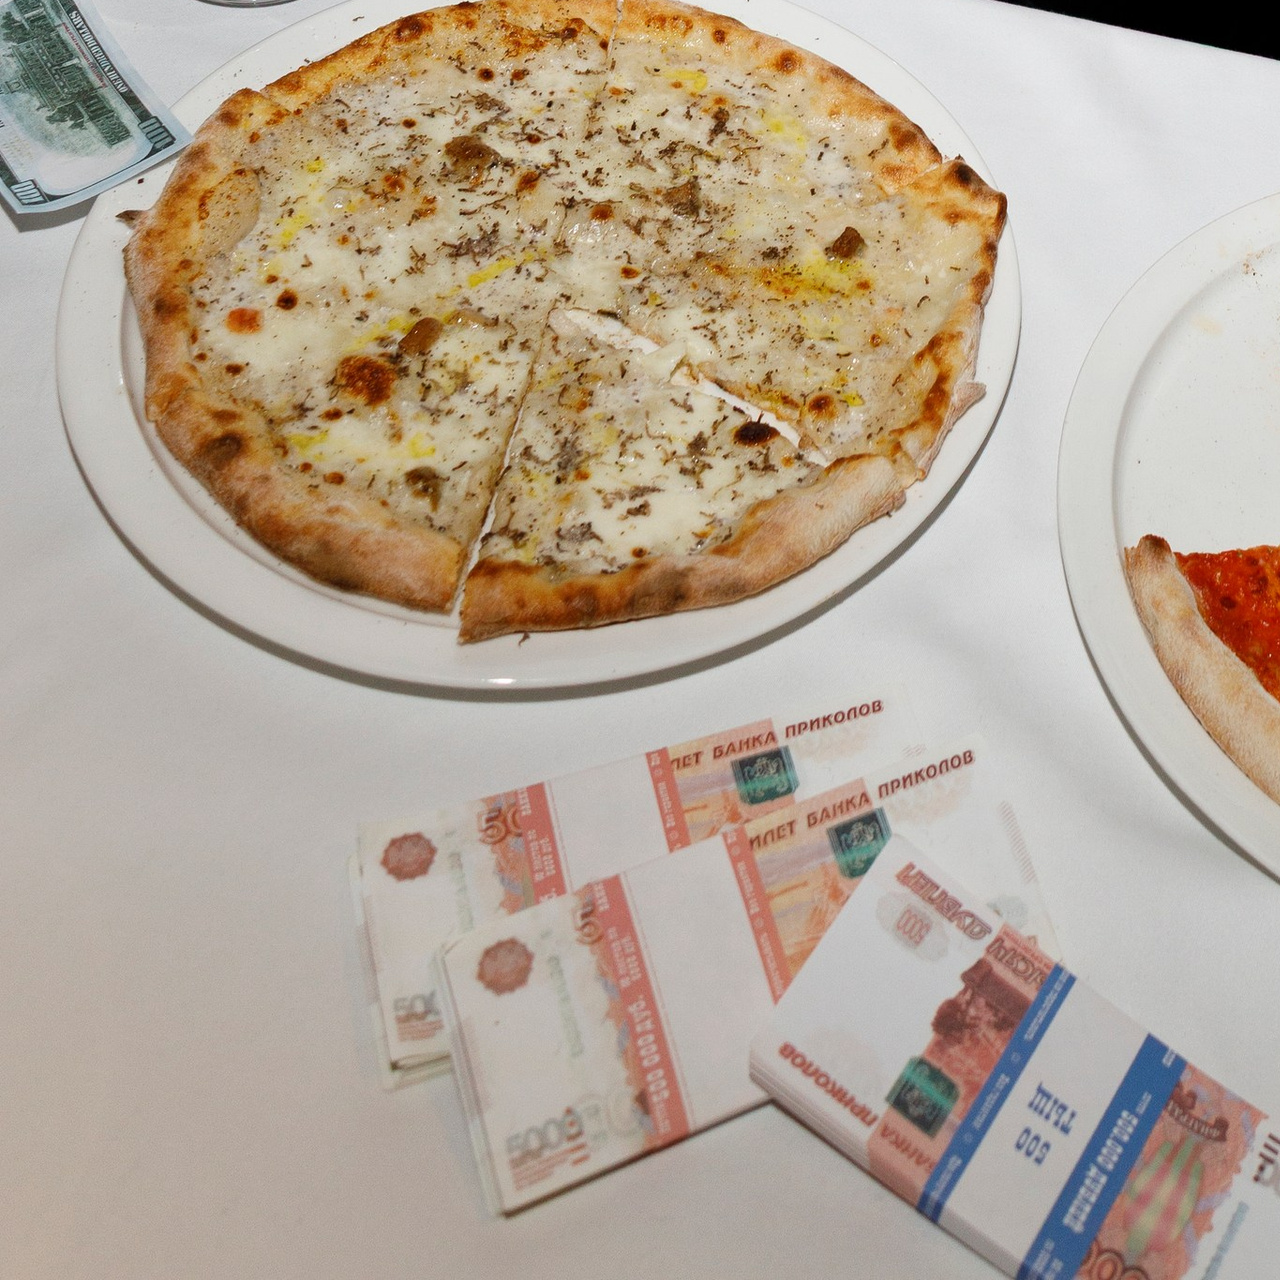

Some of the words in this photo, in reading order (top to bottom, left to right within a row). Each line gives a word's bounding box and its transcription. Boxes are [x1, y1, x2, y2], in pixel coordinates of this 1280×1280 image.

[68, 9, 98, 48] DOLLARS
[710, 730, 778, 761] БАНКА
[783, 698, 886, 739] ПРИКОЛОВ
[805, 791, 871, 828] БАНКА
[878, 748, 976, 799] ПРИКОЛОВ
[893, 860, 993, 944] ДУБЛЕЙ
[775, 1039, 880, 1129] ПРИКОЛОВ
[1025, 1081, 1082, 1134] ТЫЩ
[1012, 1125, 1055, 1167] 500
